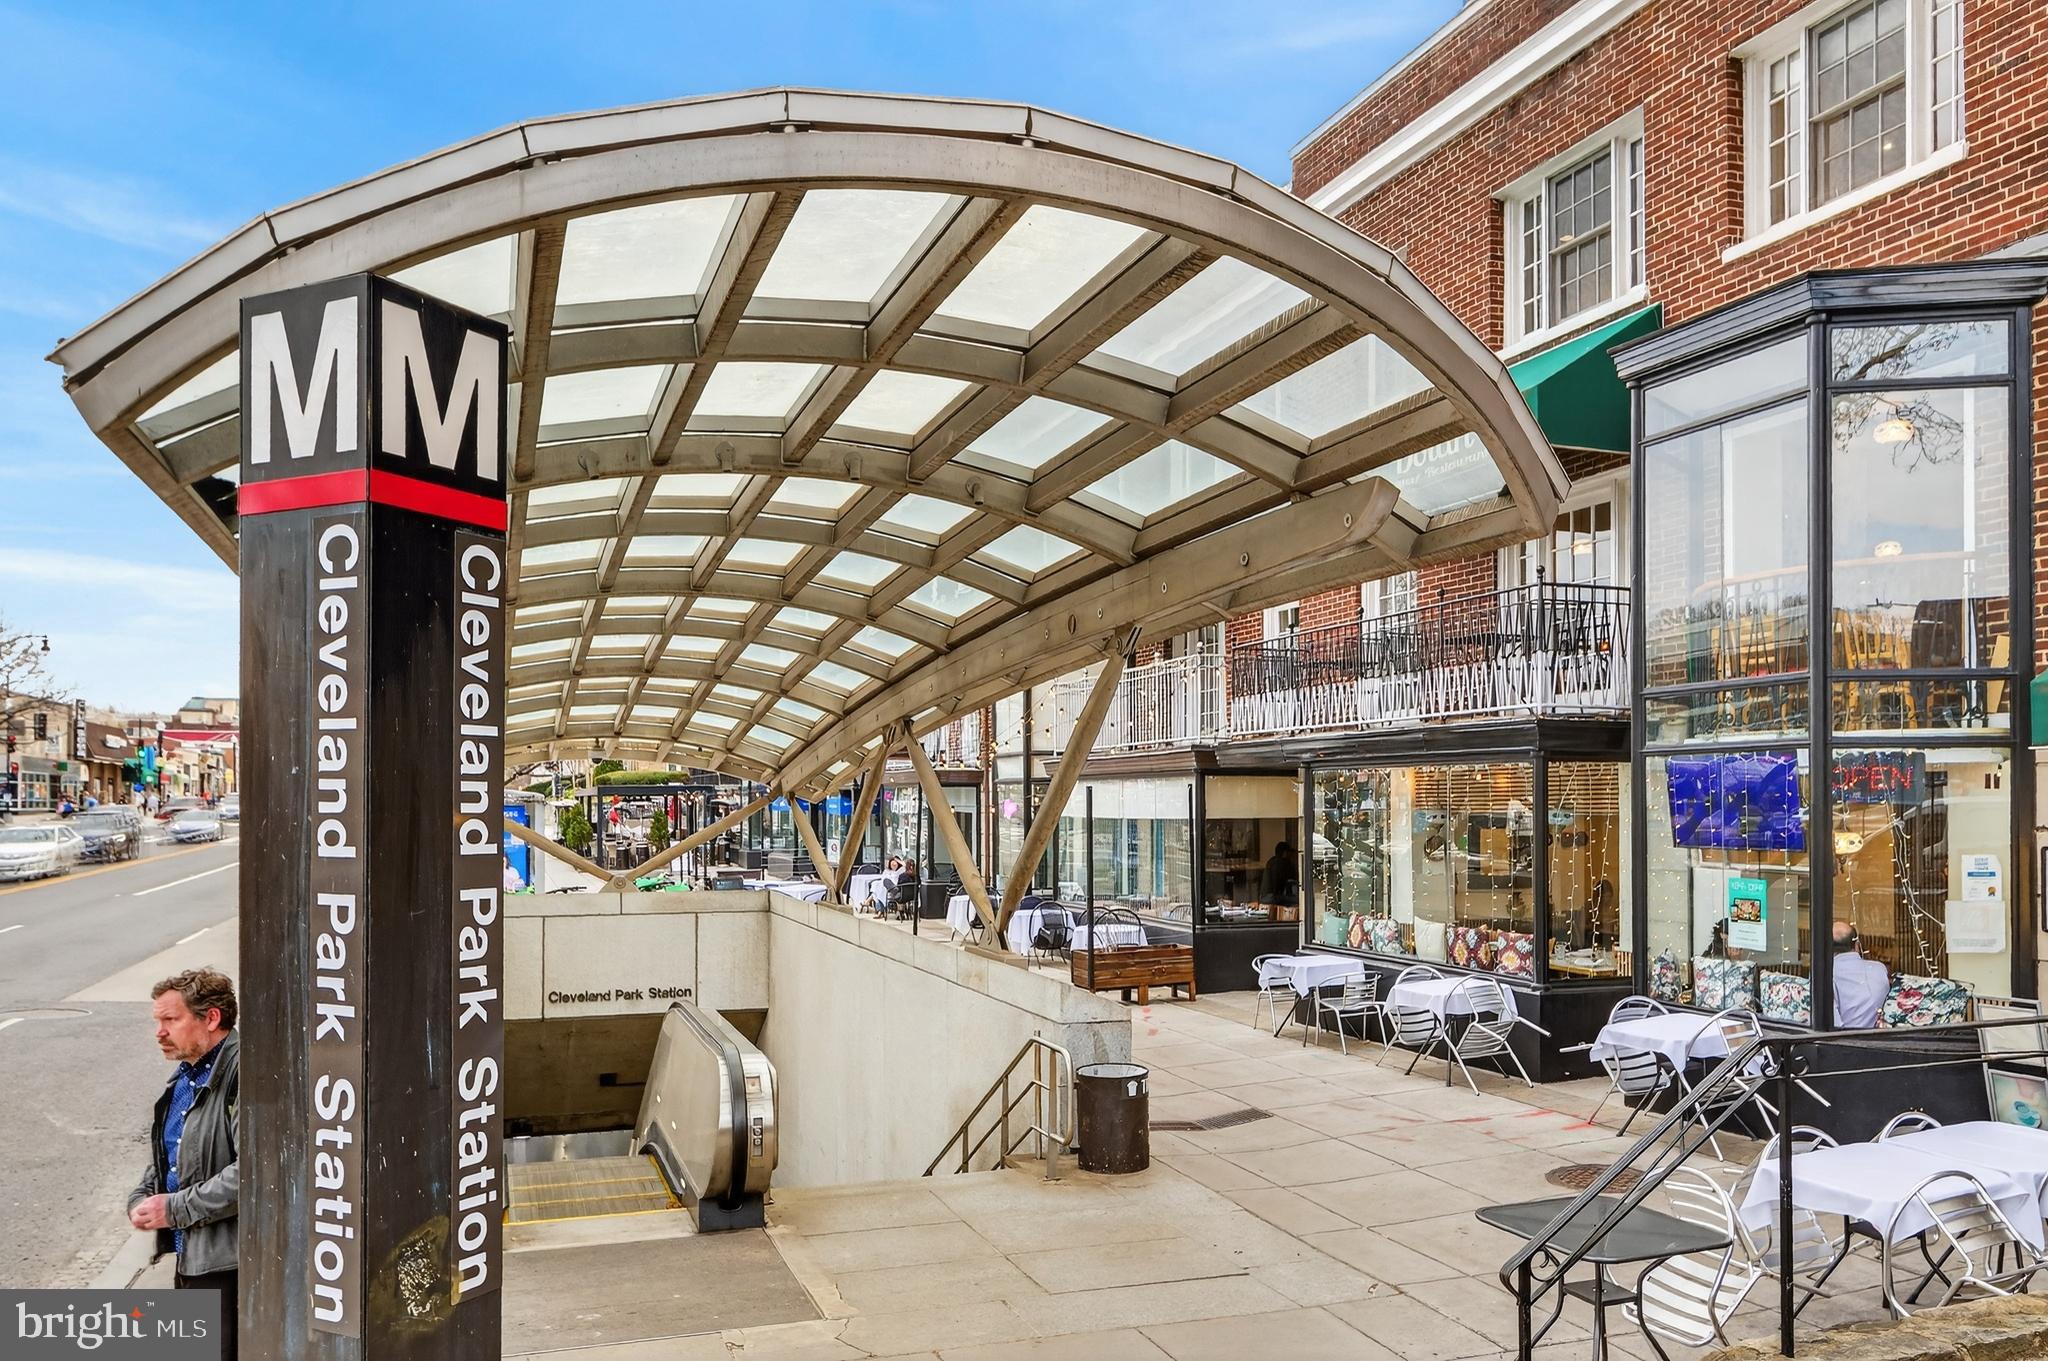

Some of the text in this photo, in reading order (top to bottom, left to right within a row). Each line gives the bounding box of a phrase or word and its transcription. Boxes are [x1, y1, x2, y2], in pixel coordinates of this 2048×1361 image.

[251, 296, 358, 464] M
[382, 298, 499, 481] M
[1832, 765, 1914, 790] OPEN
[314, 523, 359, 1324] Cleveland Park Station
[457, 544, 501, 1293] Cleveland Park Station
[548, 986, 692, 1004] Cleveland Park Station
